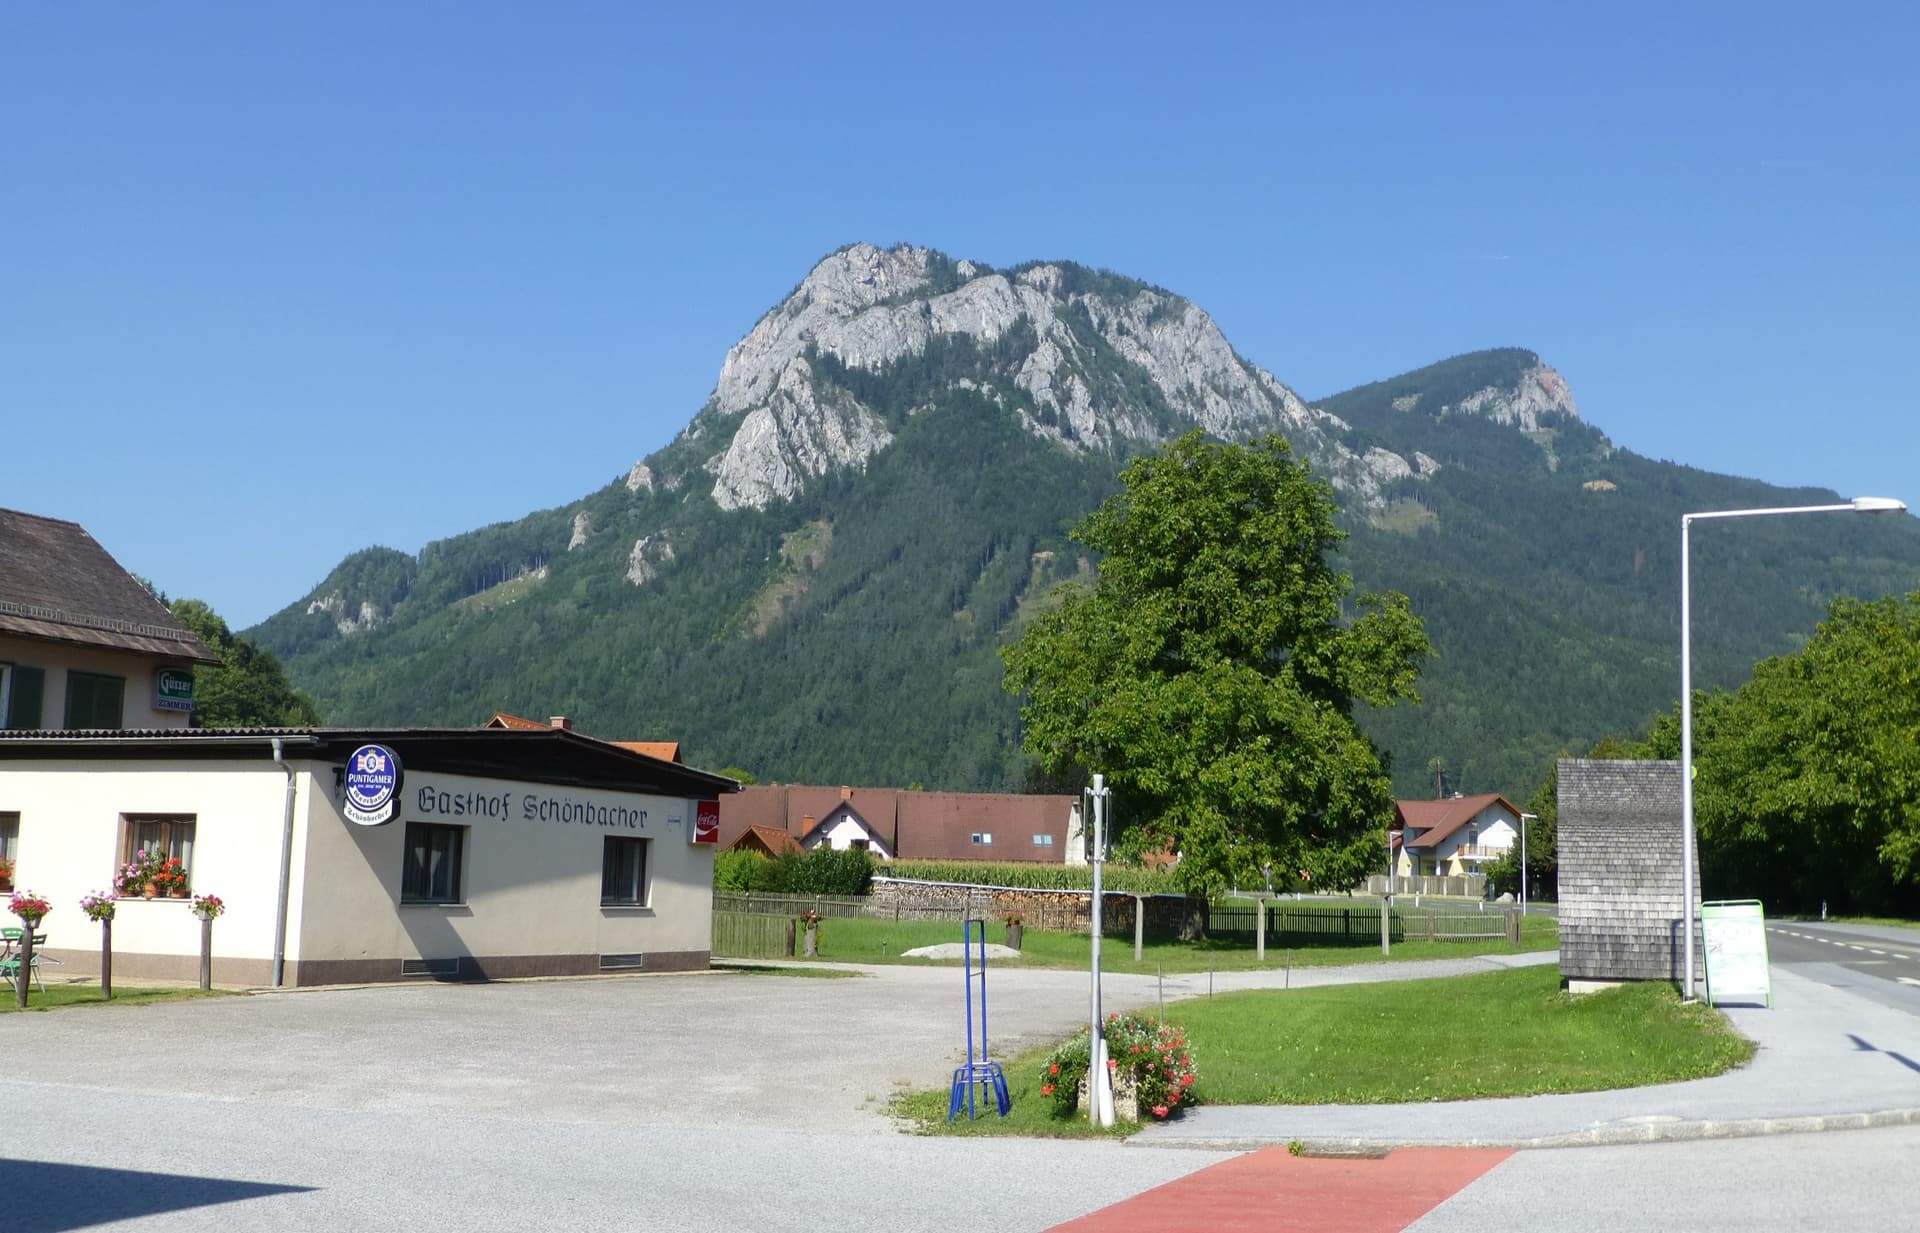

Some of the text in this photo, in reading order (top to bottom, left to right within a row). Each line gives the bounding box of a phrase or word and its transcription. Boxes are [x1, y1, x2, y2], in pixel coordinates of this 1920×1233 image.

[159, 699, 191, 711] ZIMMER
[348, 773, 393, 785] PUNTIGAMER
[418, 785, 648, 829] Gasthof Schönbacher
